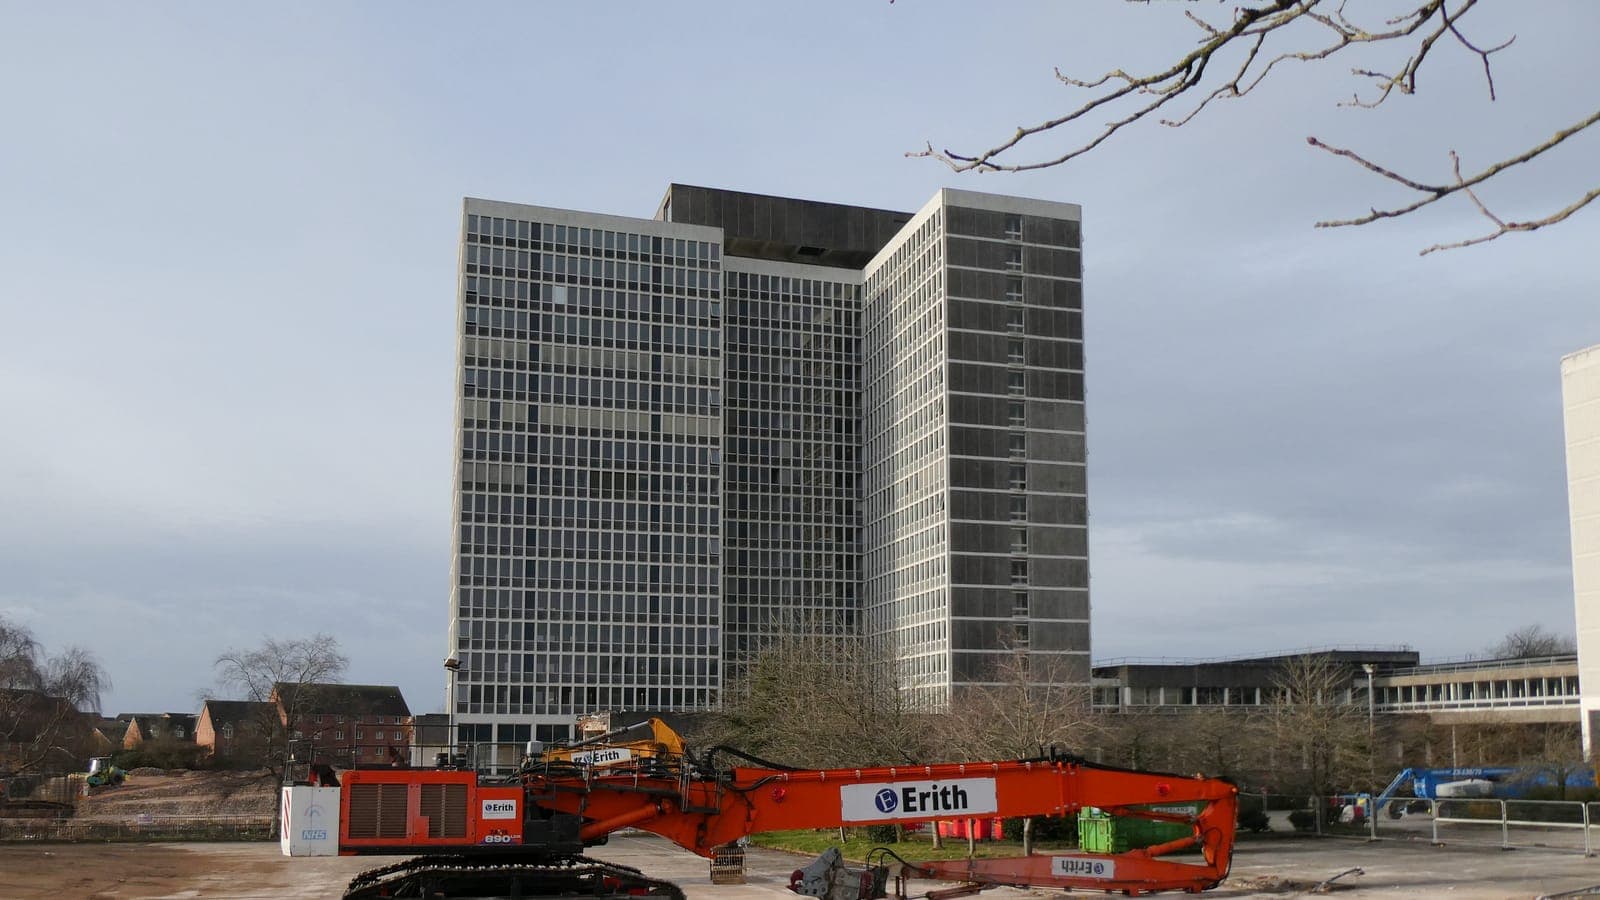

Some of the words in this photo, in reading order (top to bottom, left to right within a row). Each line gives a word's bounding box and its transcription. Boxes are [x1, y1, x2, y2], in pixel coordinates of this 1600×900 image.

[593, 751, 620, 763] Erith
[902, 784, 968, 813] Erith
[493, 803, 514, 812] Erith
[303, 830, 327, 840] NHS
[485, 835, 511, 843] 890
[1061, 860, 1093, 874] Erith
